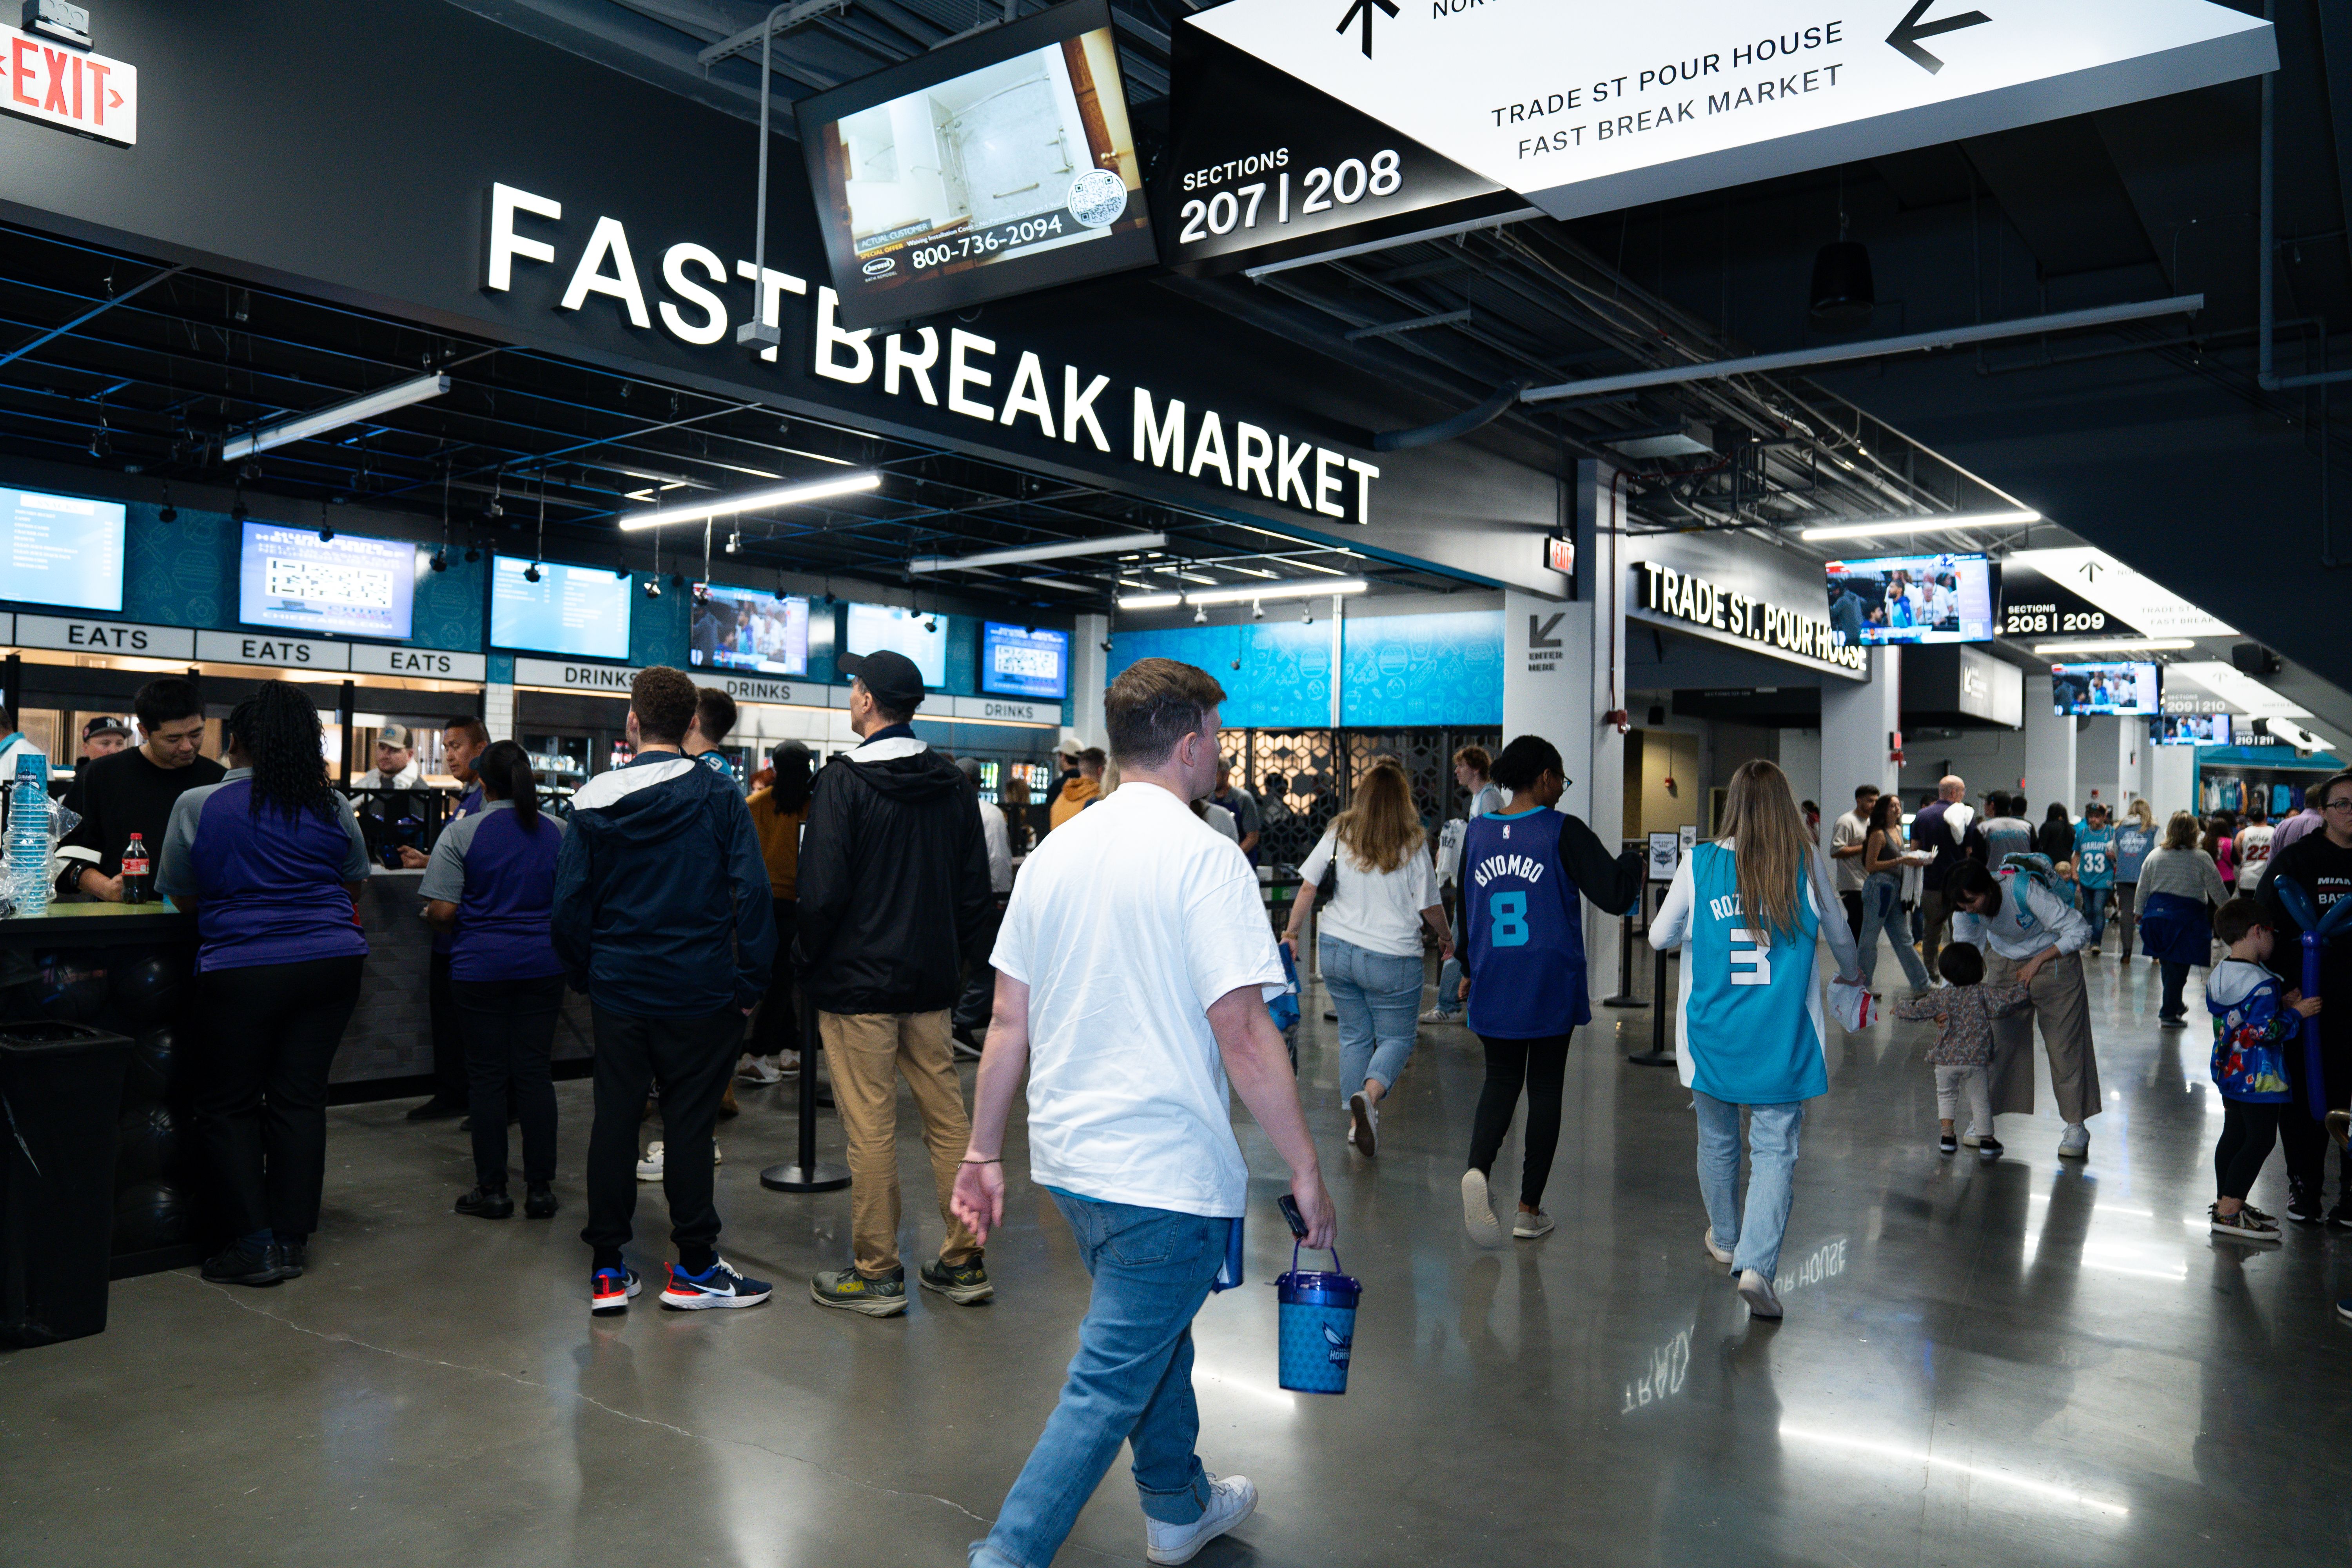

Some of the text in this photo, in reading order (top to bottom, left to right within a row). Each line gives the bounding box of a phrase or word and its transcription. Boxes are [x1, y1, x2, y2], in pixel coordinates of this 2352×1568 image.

[13, 37, 110, 126] EXIT
[1491, 20, 1844, 128] TRADE ST POUR HOUSE
[1518, 63, 1844, 160] FAST BREAK MARKET
[1183, 147, 1289, 191] SECTIONS
[1180, 182, 1267, 244] 207
[1303, 149, 1403, 214] 208
[906, 237, 929, 247] Waiving
[928, 229, 958, 241] Installation
[958, 225, 974, 233] Costs
[989, 214, 1017, 225] Payments
[1049, 200, 1065, 209] Year!
[861, 223, 929, 247] ACTUAL CUSTOMER
[912, 214, 1062, 269] 800-736-2094
[860, 243, 904, 260] SPECIAL OFFER
[1133, 386, 1380, 524] MARKET
[1554, 543, 1570, 571] EXIT
[1644, 560, 1726, 630] TRADE
[1730, 590, 1760, 641] ST.
[1764, 602, 1813, 655] POUR
[2008, 604, 2056, 614] SECTIONS
[2007, 615, 2048, 633] 208
[2063, 612, 2105, 630] 209
[68, 624, 148, 650] EATS
[241, 640, 311, 662] EATS
[1528, 651, 1563, 660] ENTER
[390, 652, 451, 673] EATS
[1528, 663, 1555, 672] HERE
[565, 667, 636, 688] DRINKS
[726, 680, 791, 700] DRINKS
[985, 703, 1034, 719] DRINKS
[2167, 701, 2193, 713] 209
[2202, 700, 2226, 712] 210
[2235, 735, 2253, 745] 210
[2259, 735, 2274, 745] 211
[2083, 852, 2105, 874] 33
[2246, 844, 2270, 860] 22
[1474, 854, 1544, 887] BIYOMBO
[1490, 891, 1529, 947] 8
[1730, 928, 1771, 986] 3
[837, 1280, 865, 1293] HOKA
[1329, 1350, 1349, 1361] HORNE
